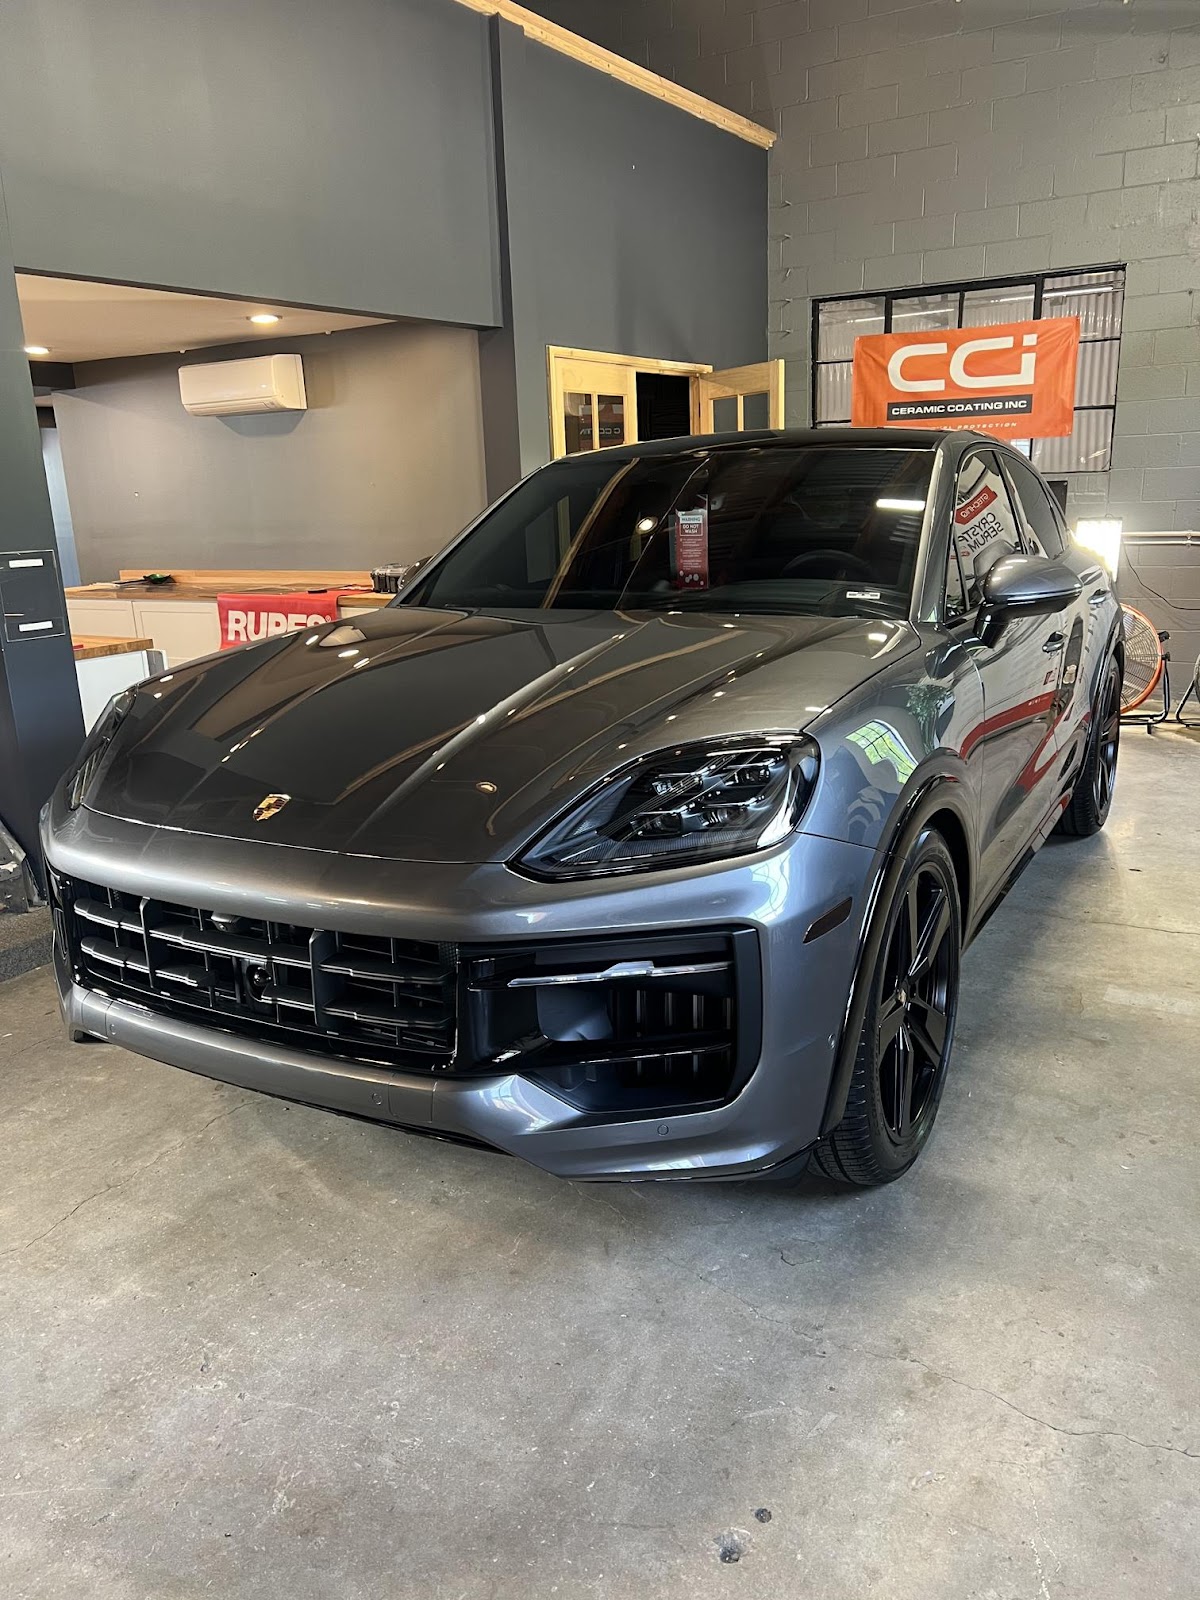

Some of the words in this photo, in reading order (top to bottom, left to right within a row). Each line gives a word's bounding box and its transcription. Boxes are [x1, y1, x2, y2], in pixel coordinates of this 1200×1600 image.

[891, 404, 946, 415] CERAMIC
[947, 401, 1003, 412] COATING
[1004, 400, 1027, 409] INC
[957, 422, 1017, 430] PROTECTION
